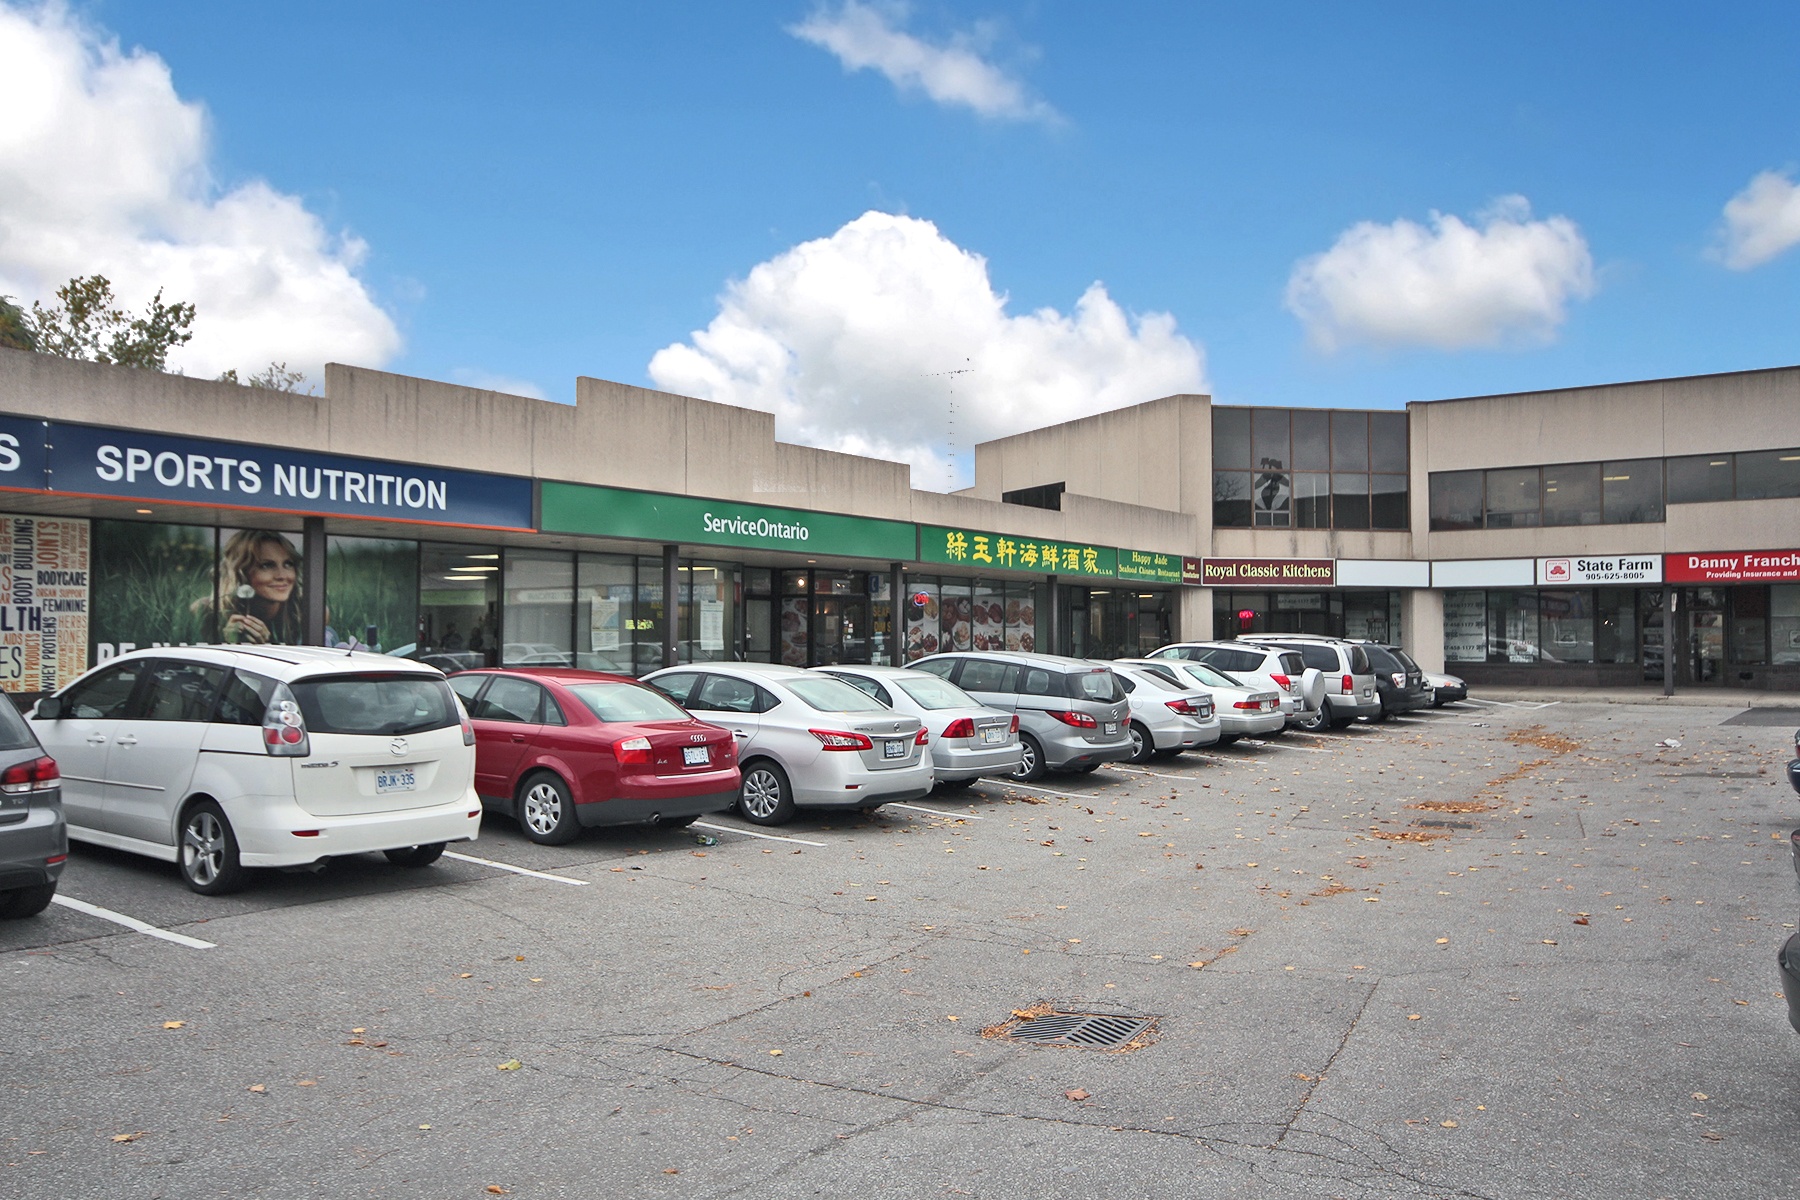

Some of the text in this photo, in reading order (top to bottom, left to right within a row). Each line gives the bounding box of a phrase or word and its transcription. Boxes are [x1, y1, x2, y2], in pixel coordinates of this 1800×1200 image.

[0, 433, 21, 472] S
[95, 445, 447, 510] SPORTS NUTRITION
[703, 512, 809, 541] ServiceOntario
[36, 521, 60, 569] JOINTS
[13, 518, 34, 604] BODY BUILDING
[1132, 551, 1168, 565] Happy Jade
[1577, 558, 1653, 572] State Farm
[1688, 556, 1739, 570] Danny
[37, 570, 87, 586] BODYCARE
[1118, 564, 1180, 578] Seafood Chinese Restaurant
[1204, 564, 1332, 580] Royal Classic Kitchens
[1585, 572, 1645, 580] 905-625-8005
[1706, 569, 1798, 579] Providing Insurance and
[59, 588, 86, 598] SUPPORT
[43, 598, 87, 613] FEMININE
[1, 606, 42, 631] LTH
[58, 615, 87, 629] HERBS
[3, 633, 23, 645] AIDS
[57, 630, 87, 644] BONES
[42, 616, 57, 692] WHEY PROTIENS
[24, 633, 40, 692] BATH PRODUCTS
